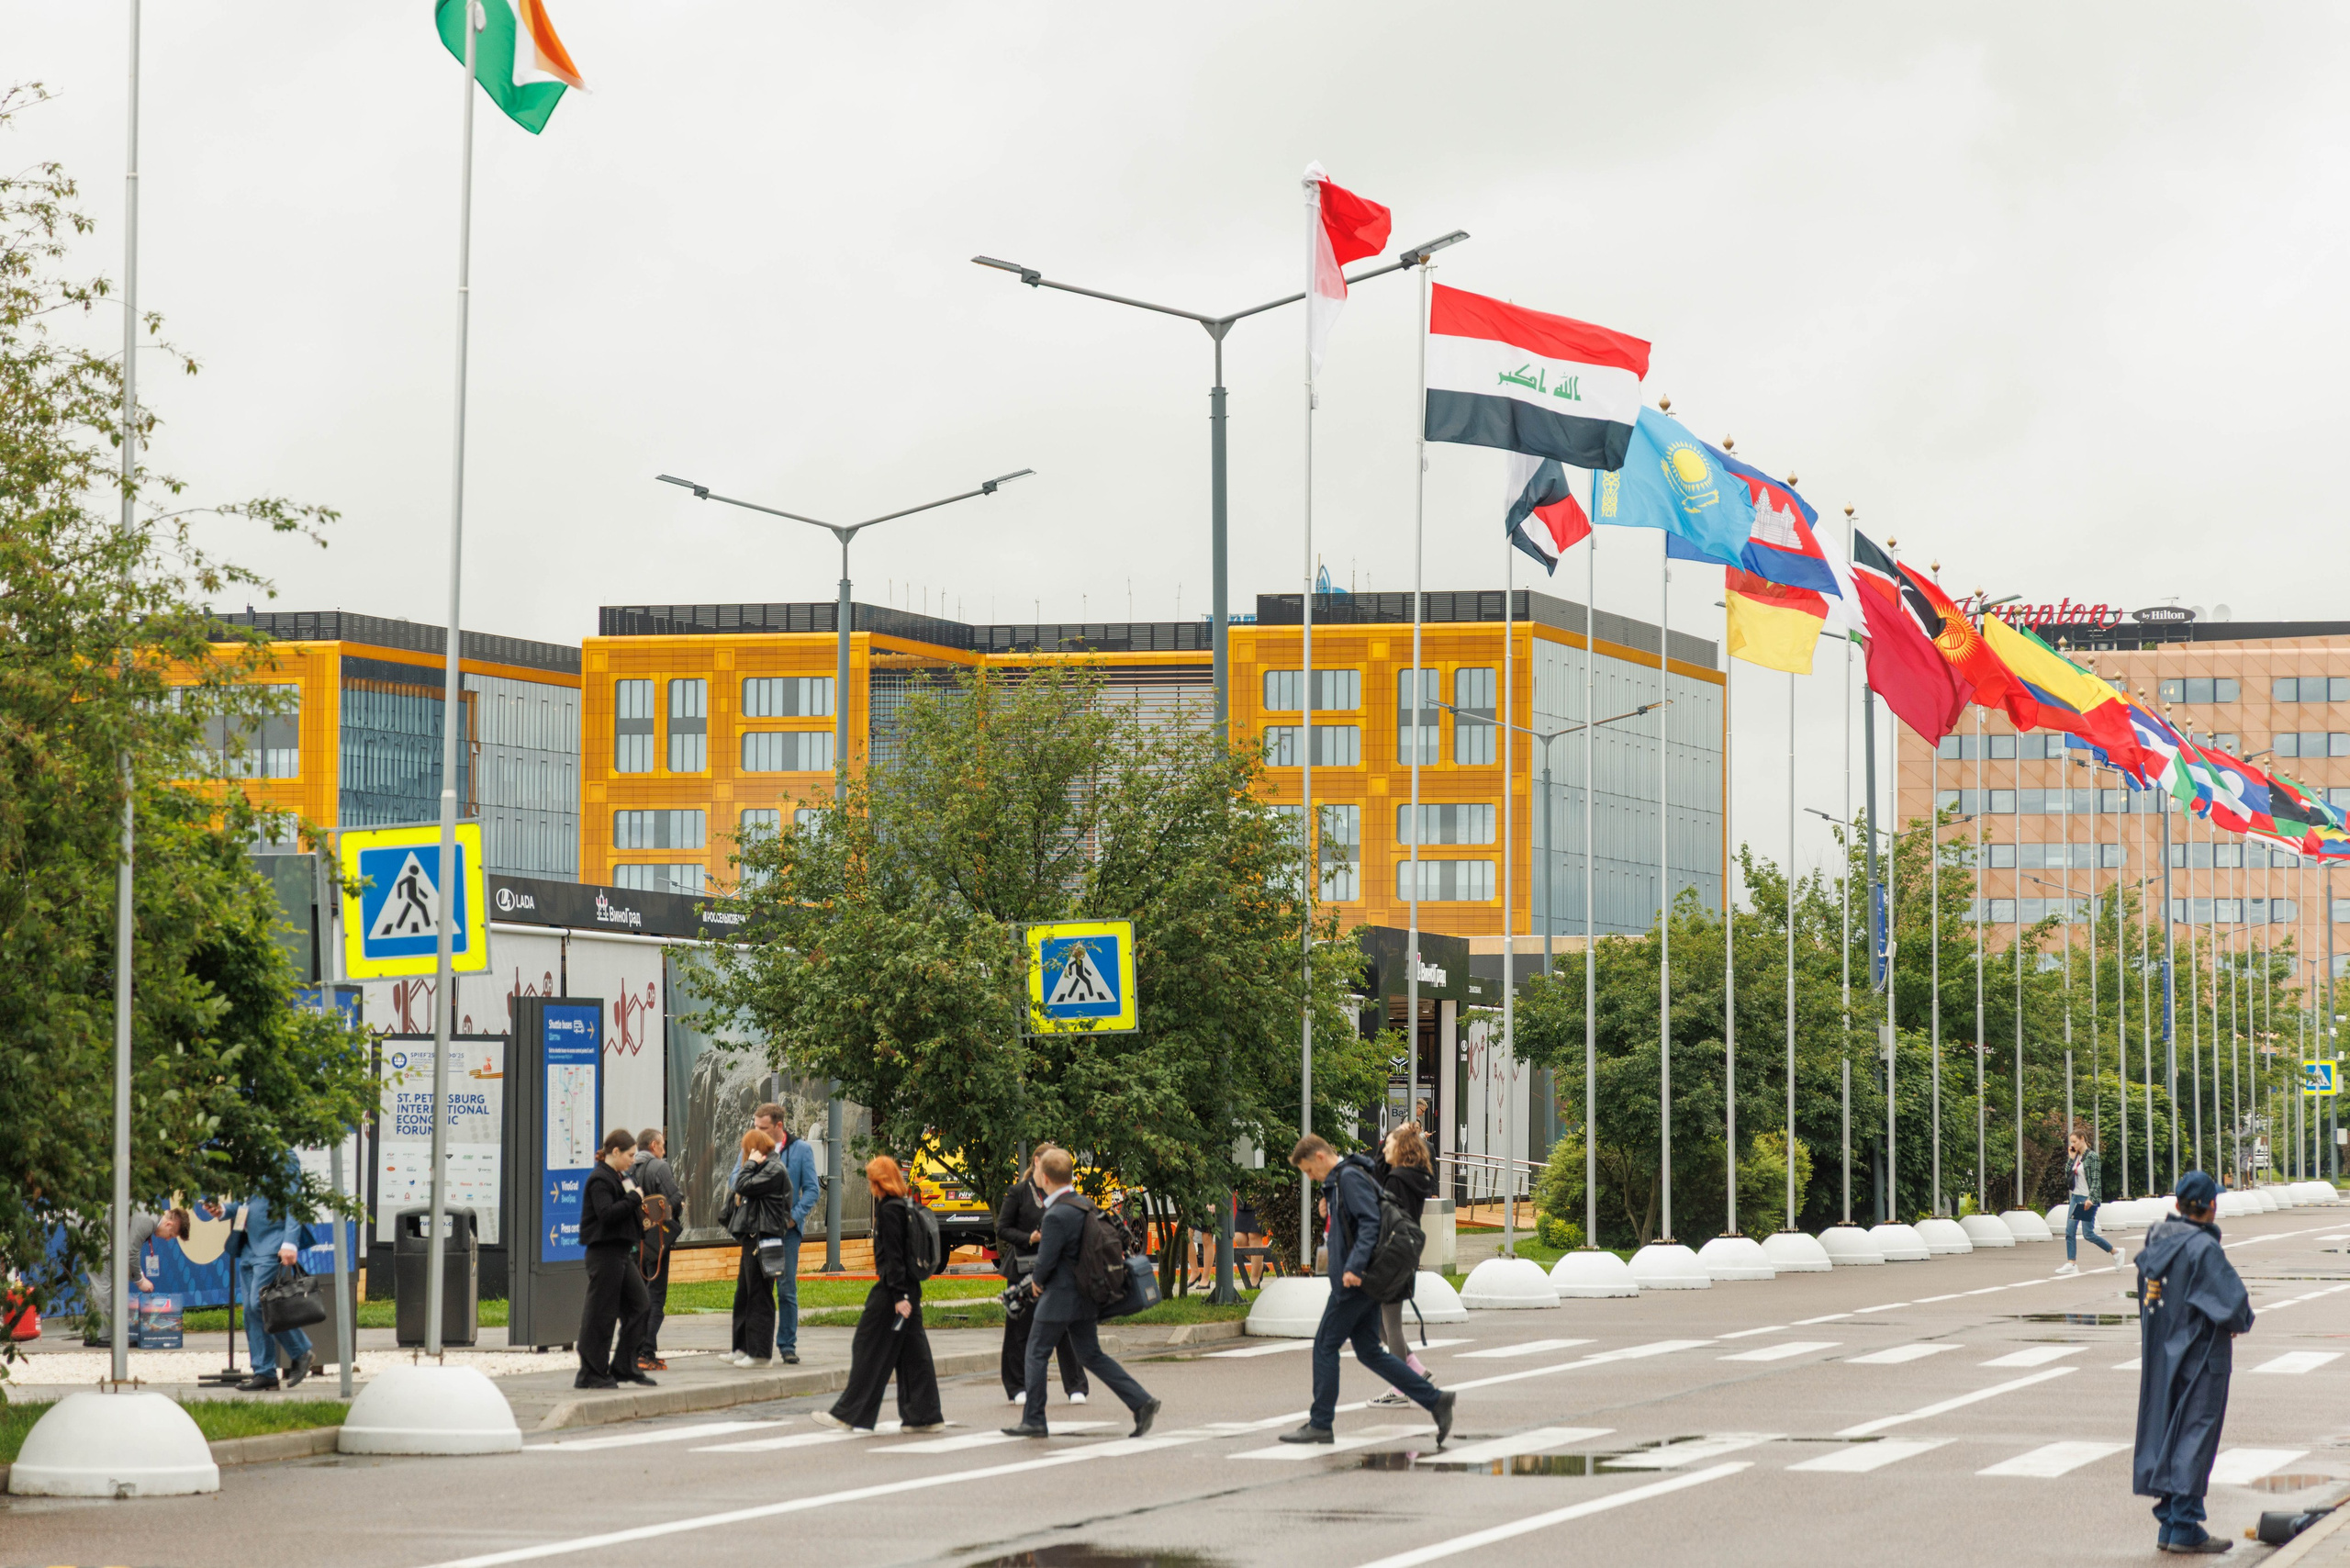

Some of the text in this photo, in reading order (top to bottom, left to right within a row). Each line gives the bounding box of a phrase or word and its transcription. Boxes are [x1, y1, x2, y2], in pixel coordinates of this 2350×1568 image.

[2151, 610, 2185, 620] Hilton
[516, 894, 535, 909] LADA
[609, 906, 641, 927] ВиноГрад
[397, 1093, 485, 1103] ST. PETSBURG
[397, 1104, 490, 1114] INTERTIONAL
[397, 1114, 459, 1125] ECONOIC
